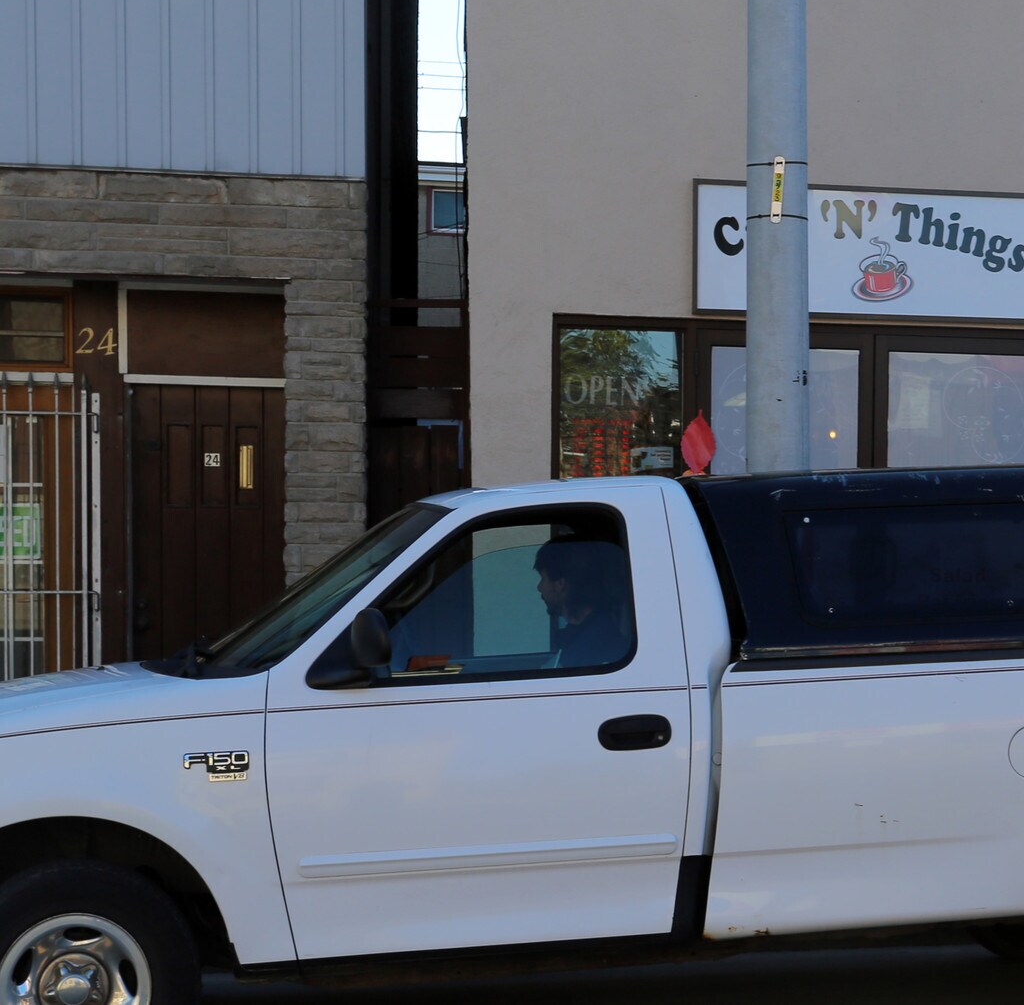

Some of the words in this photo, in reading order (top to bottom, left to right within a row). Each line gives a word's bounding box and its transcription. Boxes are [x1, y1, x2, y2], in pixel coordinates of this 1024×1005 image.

[75, 326, 118, 356] 24
[564, 372, 641, 407] OPEN
[205, 453, 220, 466] 24
